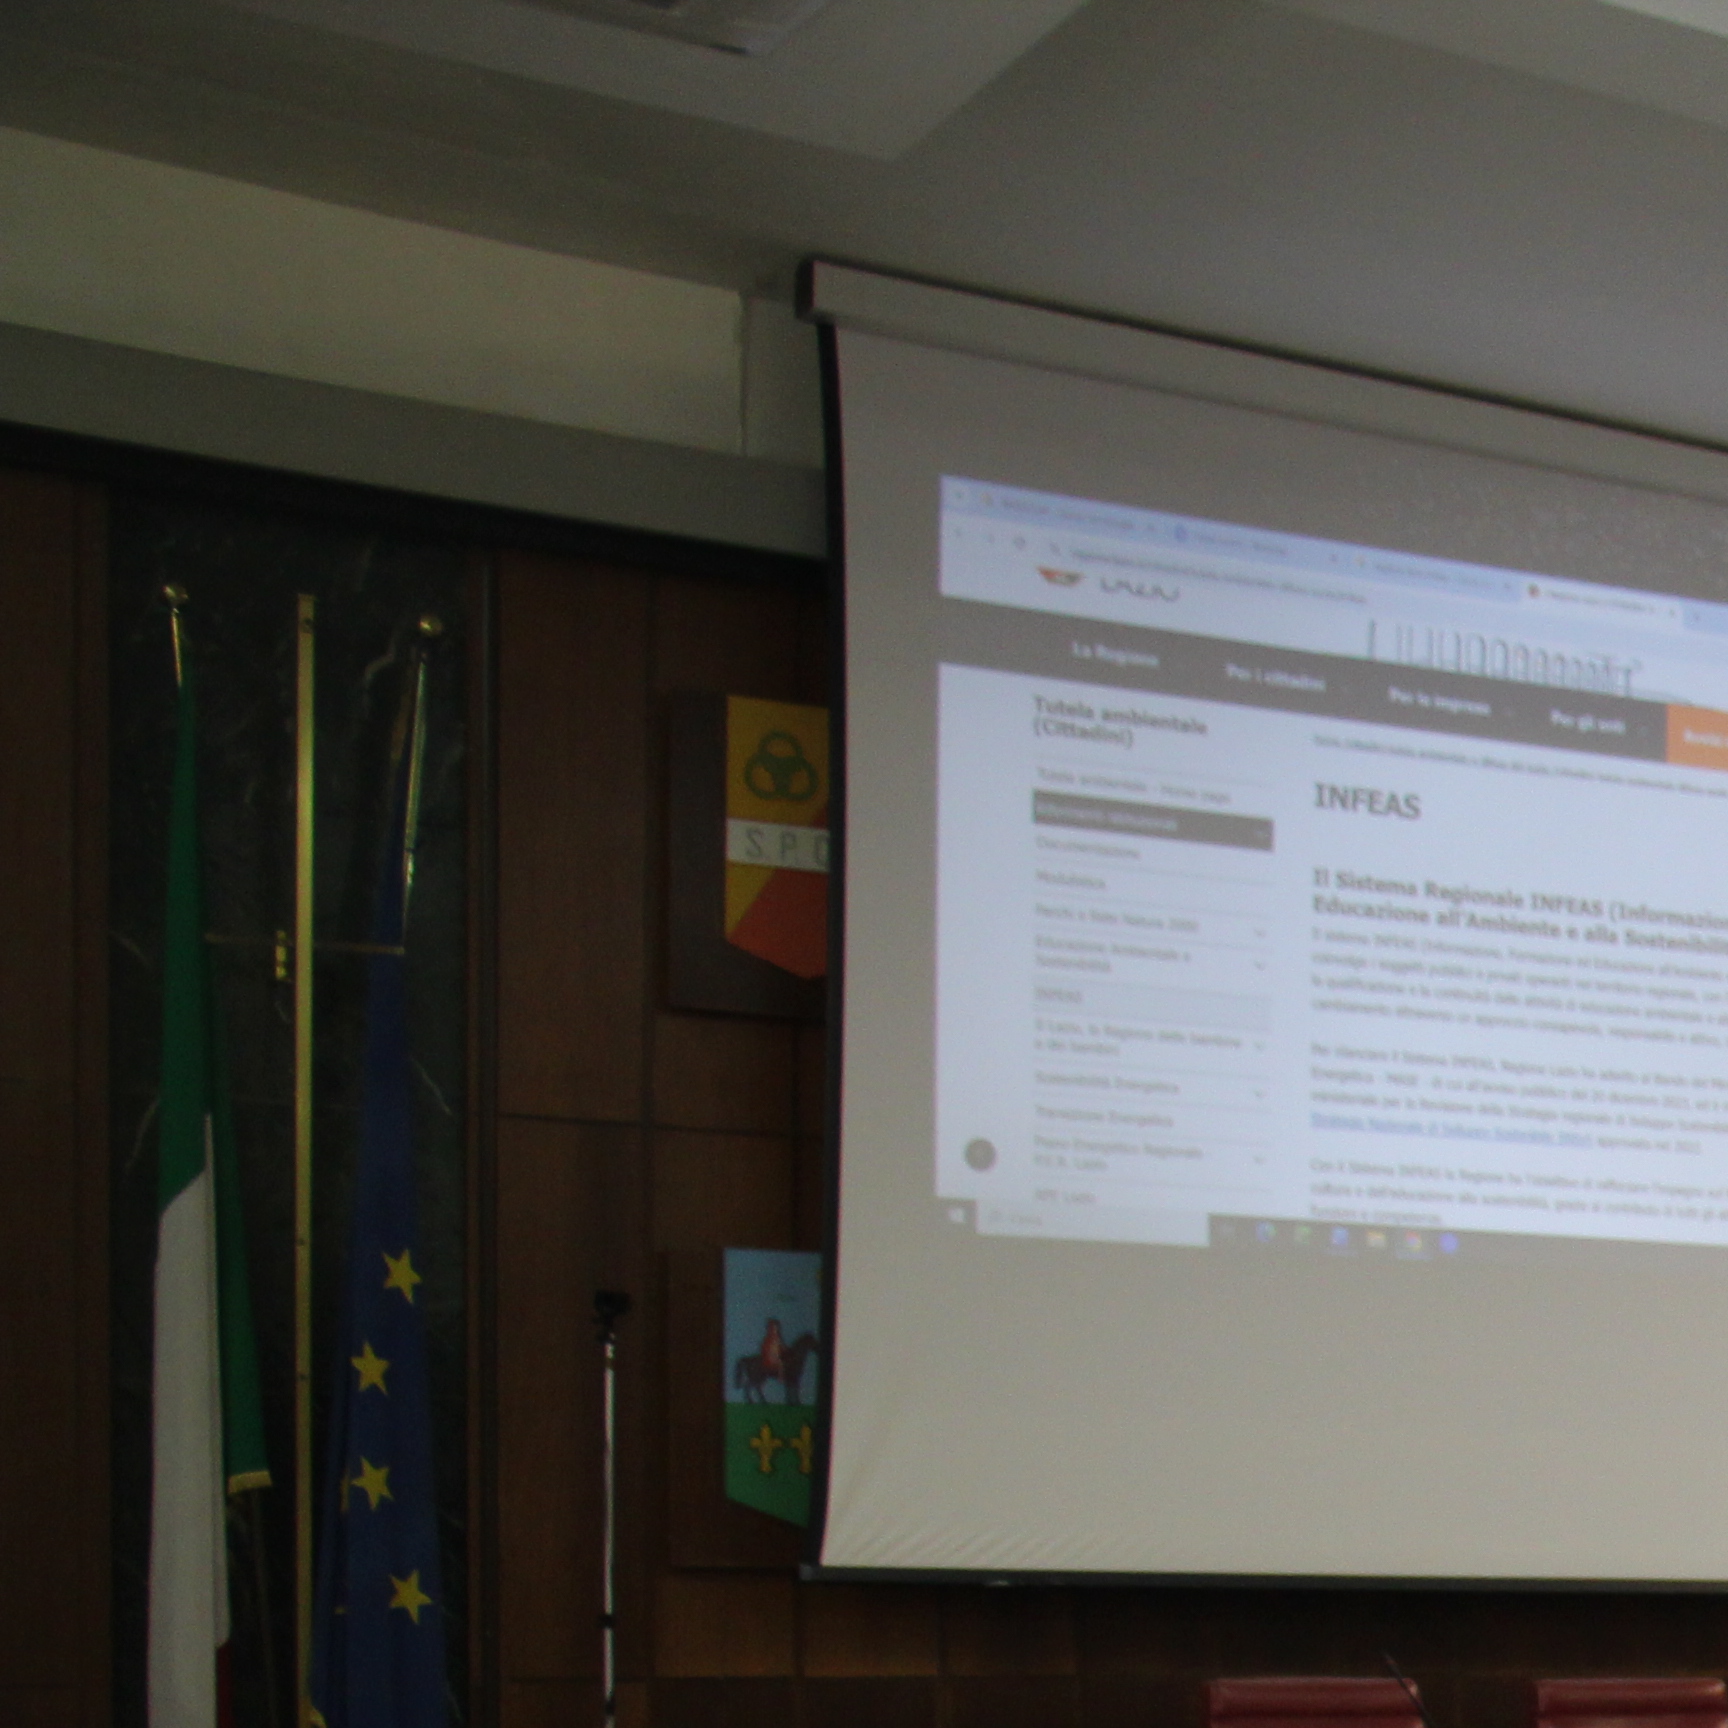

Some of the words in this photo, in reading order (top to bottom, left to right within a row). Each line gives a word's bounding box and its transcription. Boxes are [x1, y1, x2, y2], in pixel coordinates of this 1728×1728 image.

[1314, 781, 1421, 820] INFEAS
[1311, 894, 1429, 925] Educazione
[1335, 869, 1417, 897] Sistema
[1424, 880, 1523, 912] Regionale
[1530, 892, 1603, 918] INFEAS
